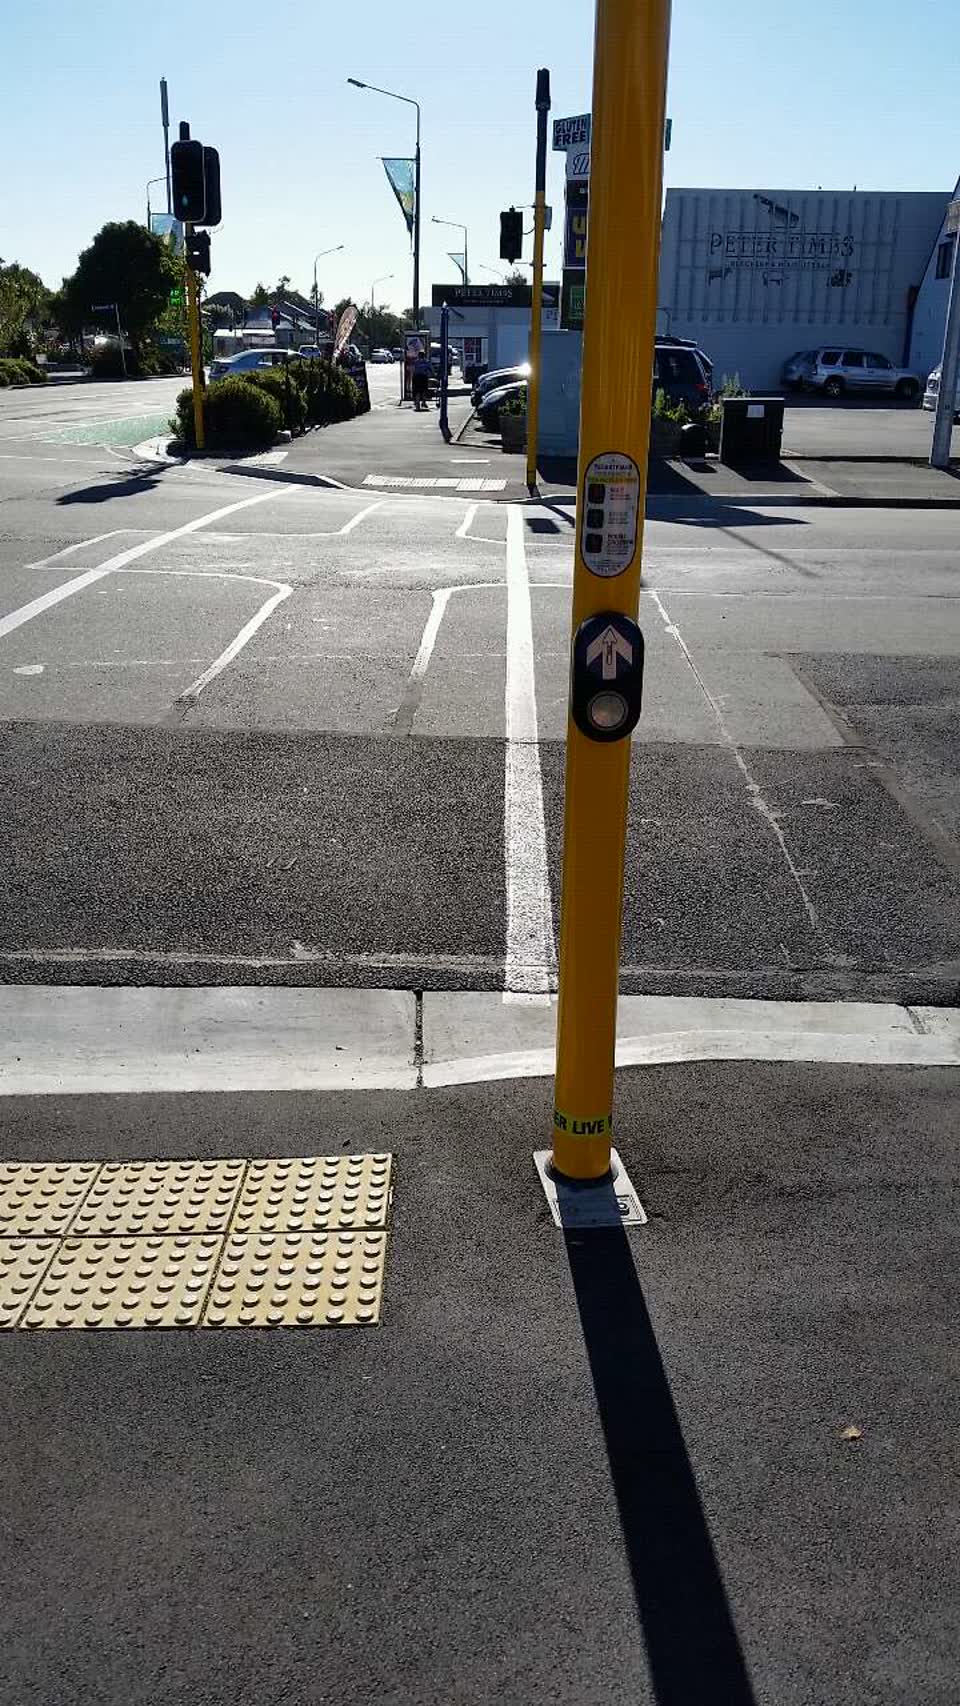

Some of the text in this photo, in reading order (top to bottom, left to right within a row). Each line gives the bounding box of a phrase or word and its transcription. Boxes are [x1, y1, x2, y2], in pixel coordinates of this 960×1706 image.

[555, 119, 587, 134] GLUTEN
[556, 131, 586, 145] FREE
[711, 233, 854, 257] PETER TIMBS
[573, 1119, 605, 1134] LIVE
